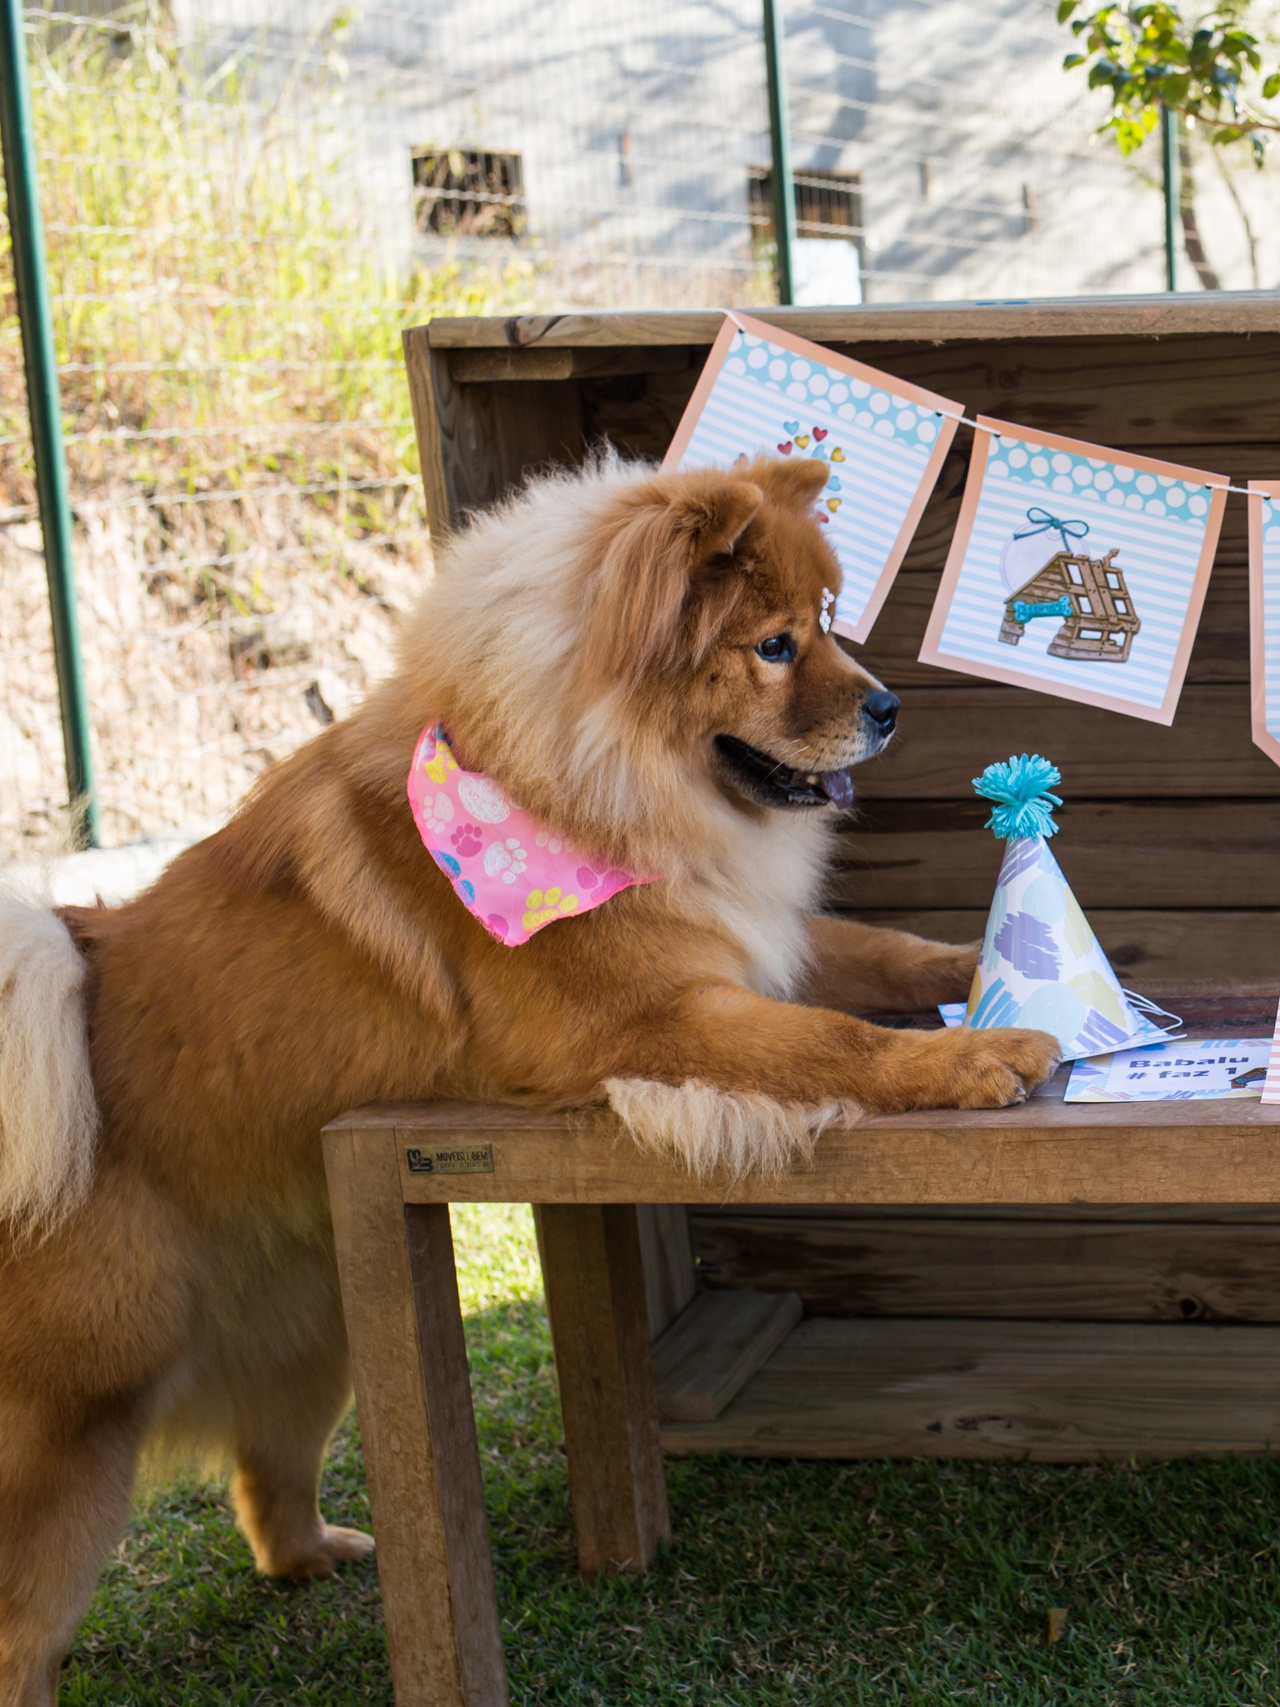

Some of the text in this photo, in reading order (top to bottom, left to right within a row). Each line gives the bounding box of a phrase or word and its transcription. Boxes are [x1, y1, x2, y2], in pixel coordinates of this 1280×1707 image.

[1129, 1056, 1250, 1069] Babalu
[1127, 1067, 1238, 1080] # faz 1
